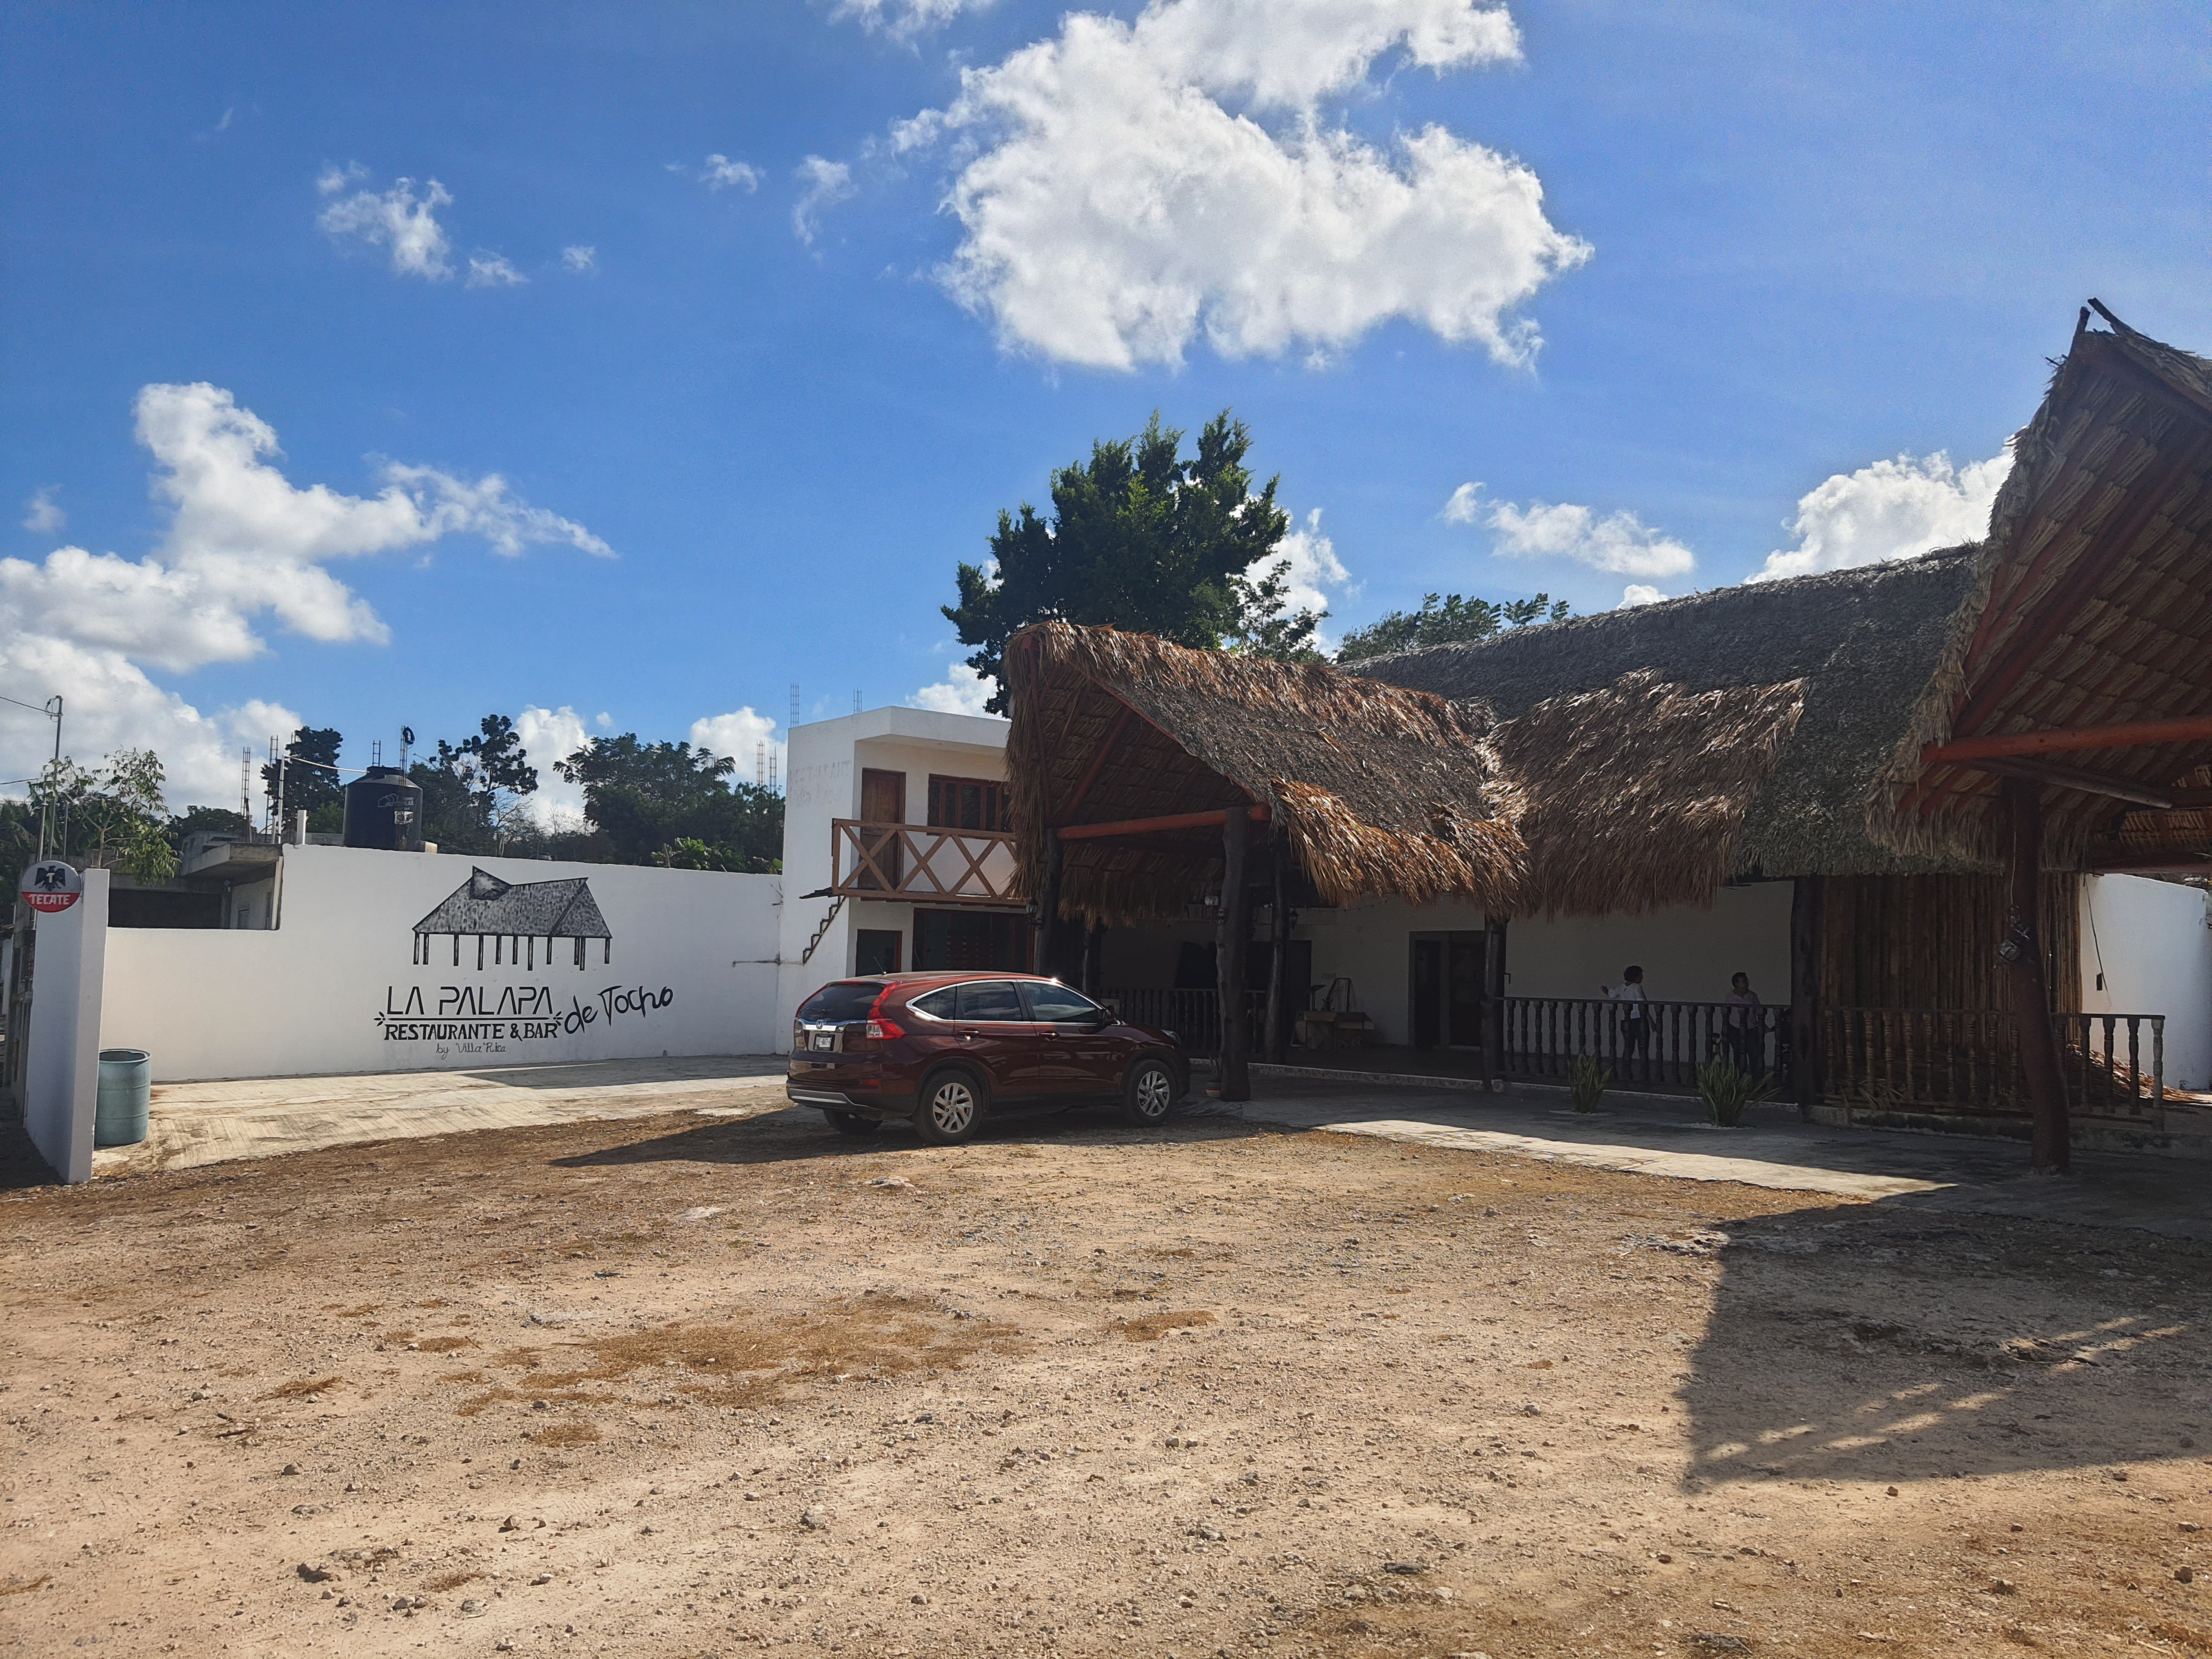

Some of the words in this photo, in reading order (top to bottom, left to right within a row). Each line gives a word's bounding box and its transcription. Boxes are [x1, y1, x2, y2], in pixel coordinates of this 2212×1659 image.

[29, 894, 71, 905] TECATE
[387, 986, 424, 1015] LA
[439, 986, 553, 1015] PALAPA
[565, 996, 599, 1035] de
[598, 985, 673, 1026] Tocho
[384, 1023, 504, 1041] RESTAURANTE
[436, 1043, 450, 1060] by
[456, 1043, 482, 1053] Villa
[483, 1042, 506, 1053] Rica
